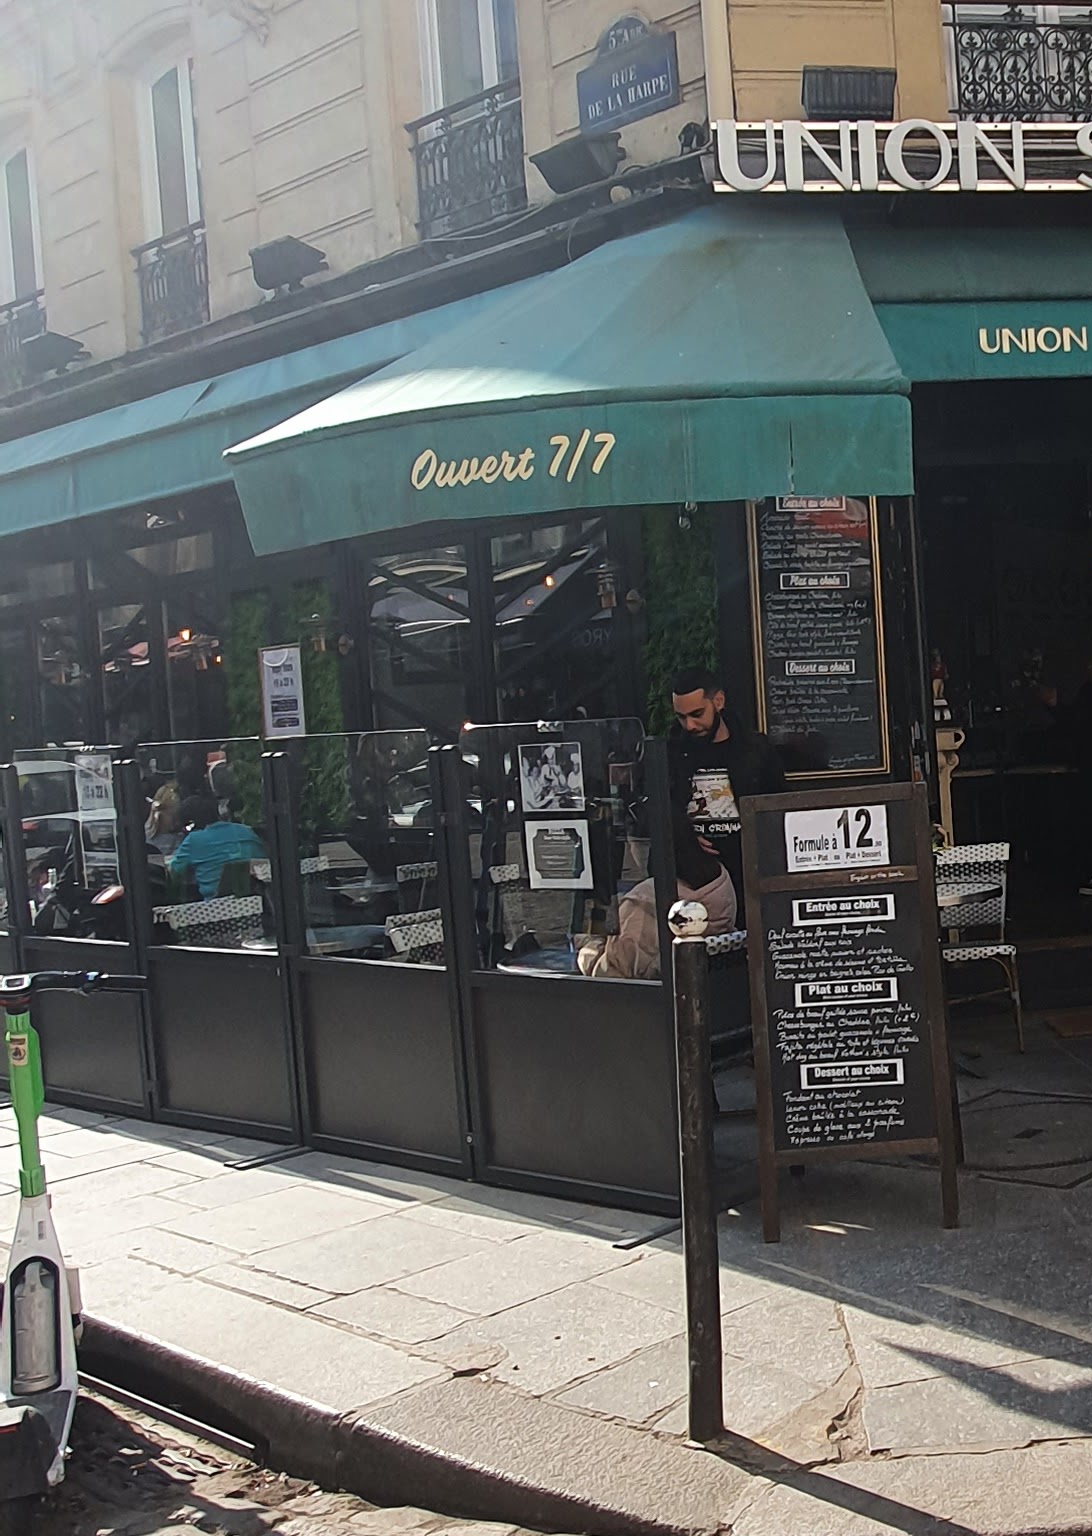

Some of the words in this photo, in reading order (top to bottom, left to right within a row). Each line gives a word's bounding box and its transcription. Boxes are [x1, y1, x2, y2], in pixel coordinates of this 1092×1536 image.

[612, 65, 637, 89] RUE
[587, 100, 604, 120] DE
[608, 94, 623, 112] LA
[628, 74, 669, 104] HARPE
[717, 118, 1025, 191] UNION
[978, 326, 1088, 354] UNION
[411, 448, 535, 490] Ouvert
[548, 428, 617, 482] 7/7
[837, 808, 873, 849] 12
[793, 835, 829, 853] Formule
[832, 833, 838, 850] à
[806, 901, 838, 913] Entrée
[839, 901, 852, 910] au
[853, 899, 881, 910] choix
[808, 983, 832, 996] Plat
[834, 984, 849, 993] au
[851, 980, 884, 993] choix
[814, 1066, 849, 1078] Dessert
[851, 1066, 863, 1076] au
[864, 1064, 890, 1075] choix
